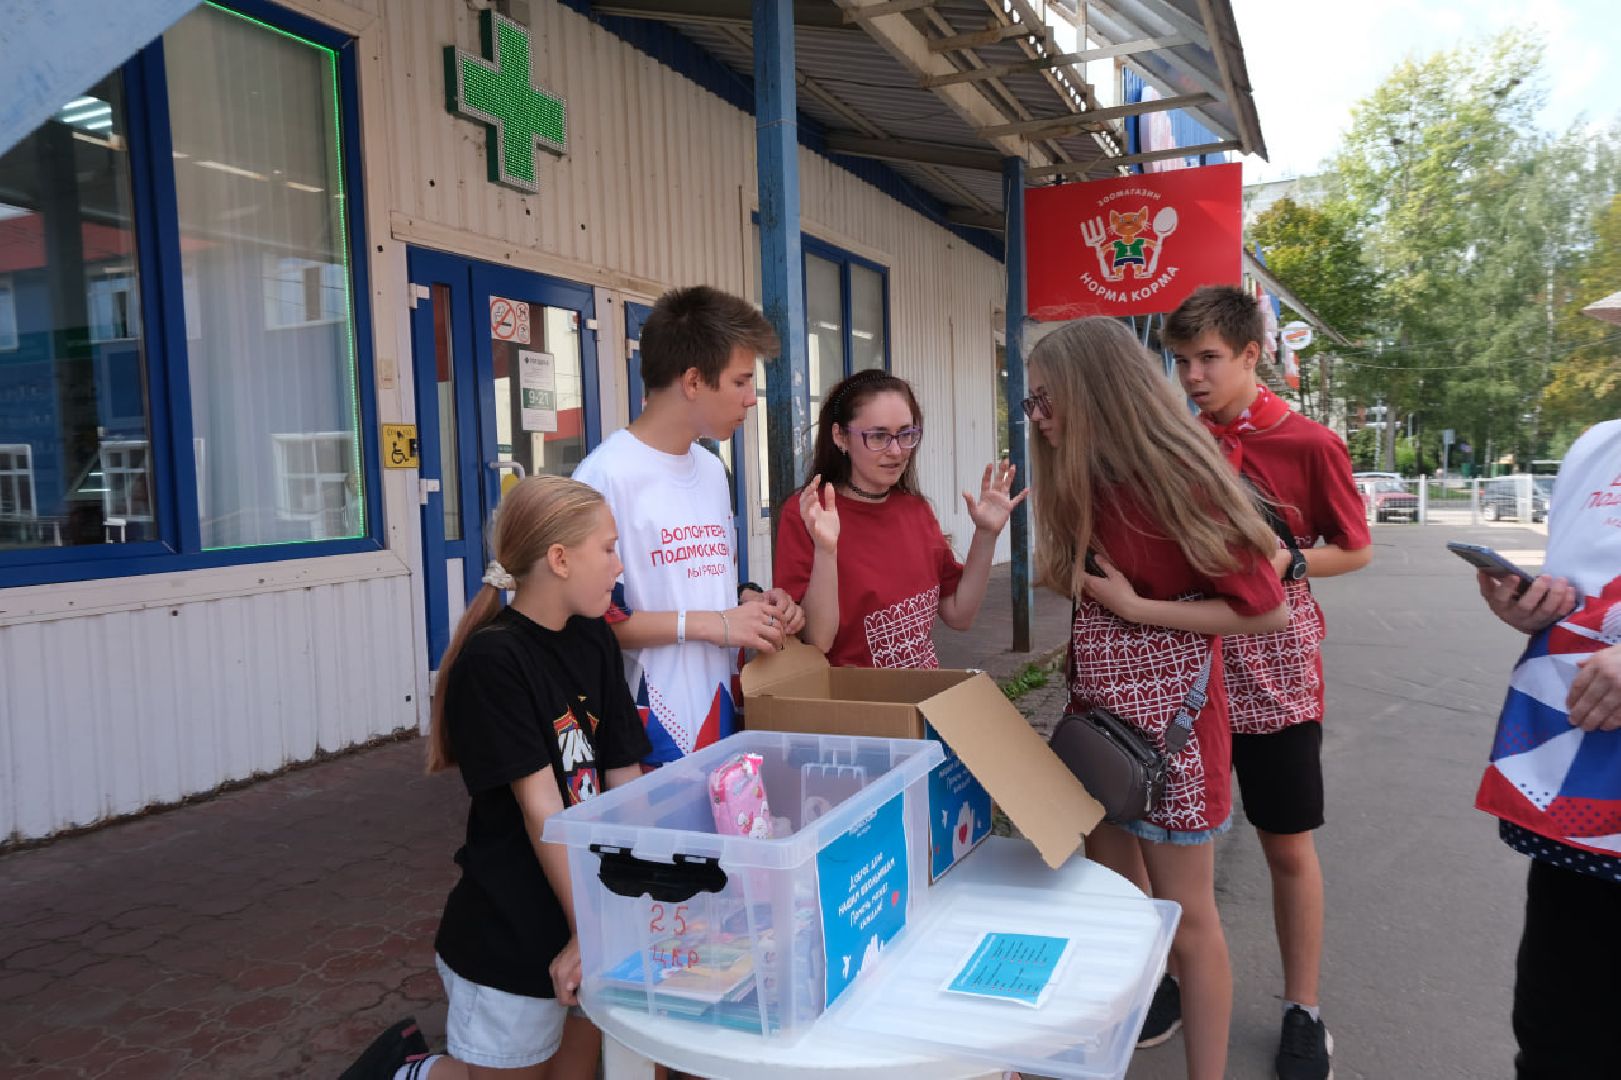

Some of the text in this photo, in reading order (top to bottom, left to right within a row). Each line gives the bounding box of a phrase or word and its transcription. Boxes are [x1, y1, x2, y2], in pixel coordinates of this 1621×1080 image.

[1096, 187, 1162, 207] ЗООМАГАЗИН
[1080, 266, 1180, 303] НОРМА КОРМА
[649, 903, 689, 936] 25
